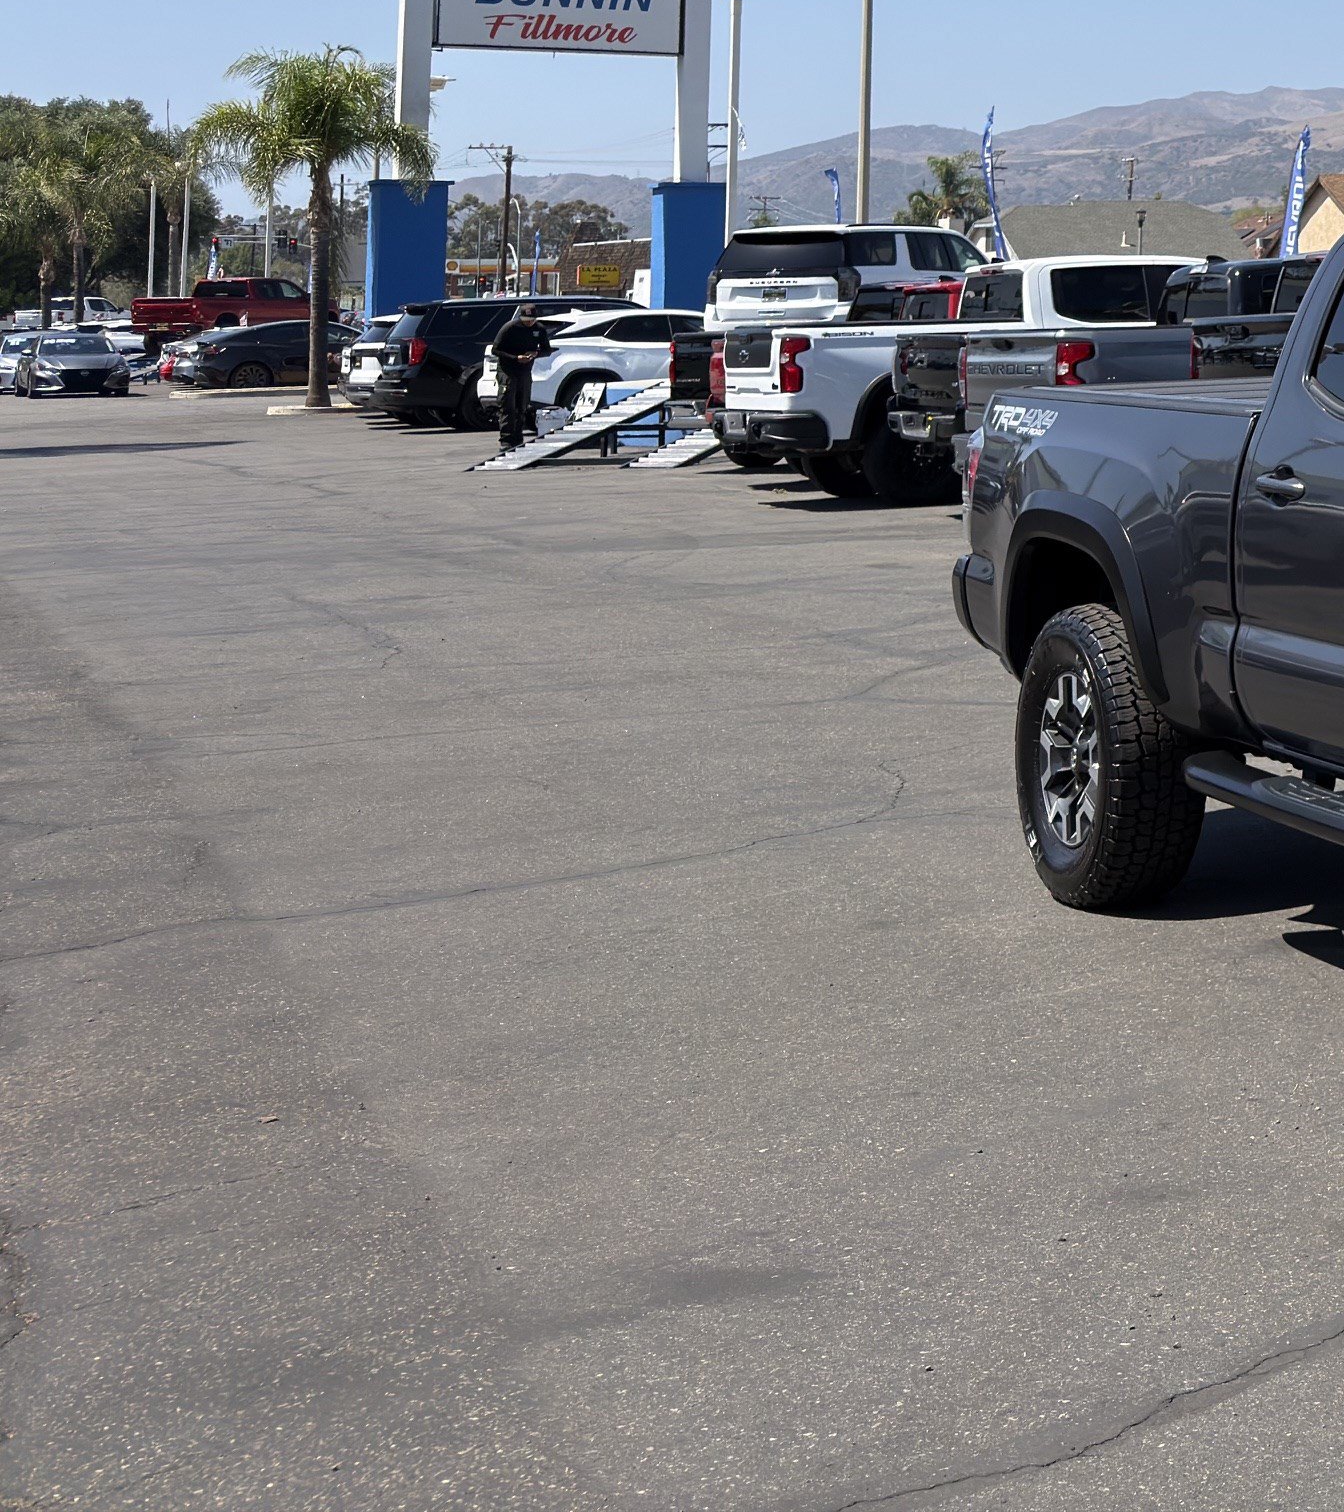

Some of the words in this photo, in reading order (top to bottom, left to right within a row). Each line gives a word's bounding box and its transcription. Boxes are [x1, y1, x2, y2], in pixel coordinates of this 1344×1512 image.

[483, 13, 637, 44] Fillmore
[968, 363, 1045, 376] CHEVROLET
[991, 404, 1027, 432] TRD
